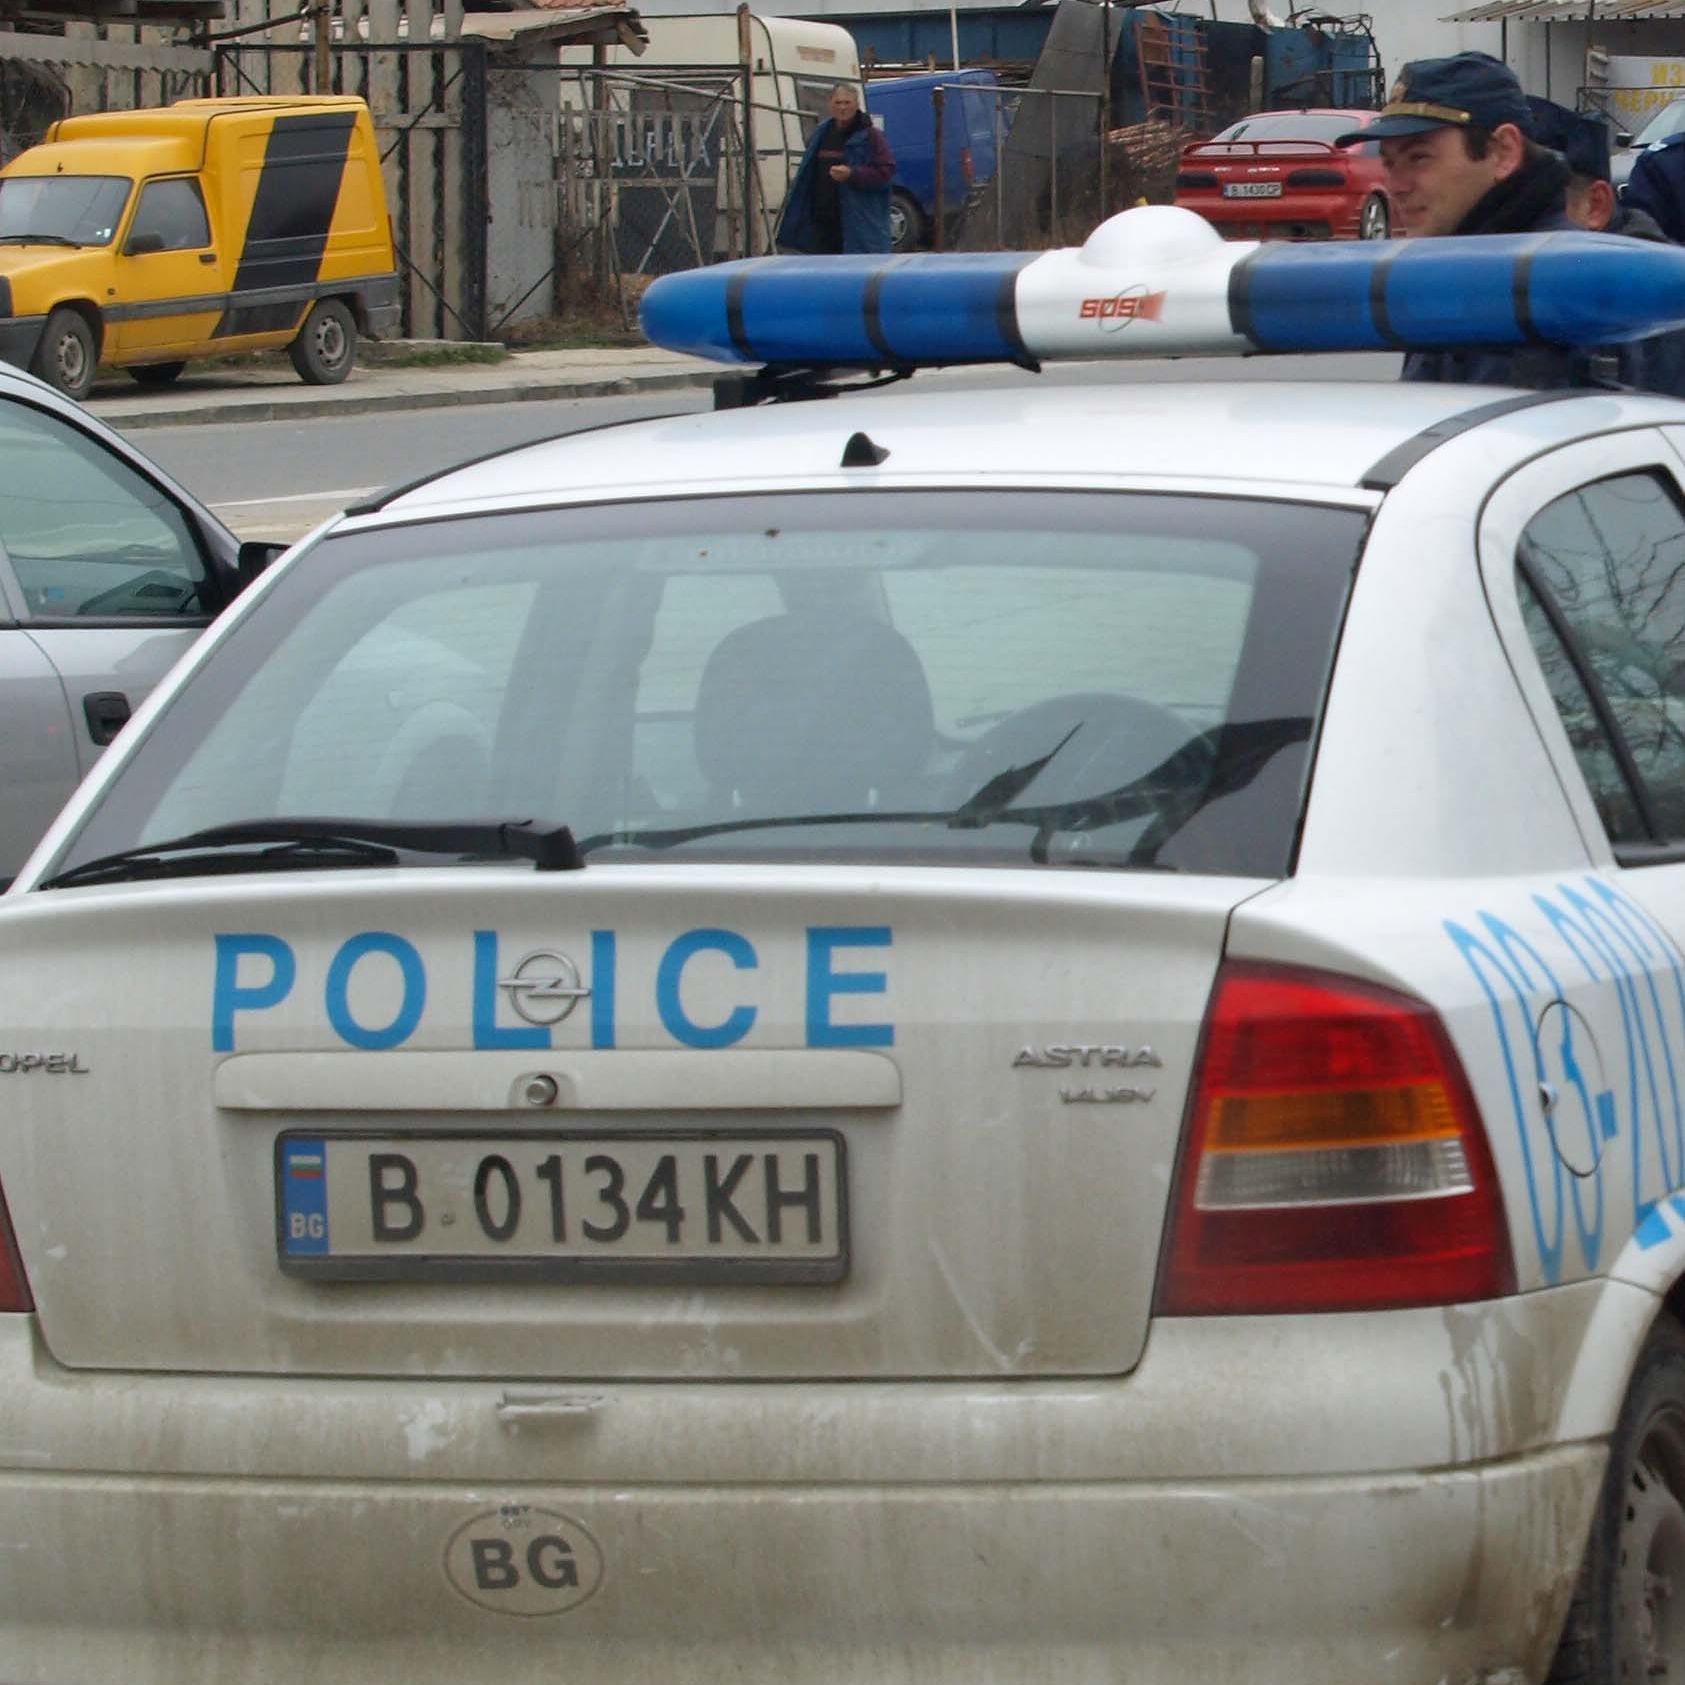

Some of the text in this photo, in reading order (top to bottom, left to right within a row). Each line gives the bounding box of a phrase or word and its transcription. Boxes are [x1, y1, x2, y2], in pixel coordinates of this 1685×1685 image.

[1079, 298, 1137, 318] SOS
[212, 925, 894, 1052] POLICE
[0, 1053, 88, 1073] OPEL
[1012, 1046, 1163, 1068] ASTRA
[368, 1153, 424, 1243] B
[289, 1212, 323, 1239] BG
[470, 1534, 579, 1590] BG
